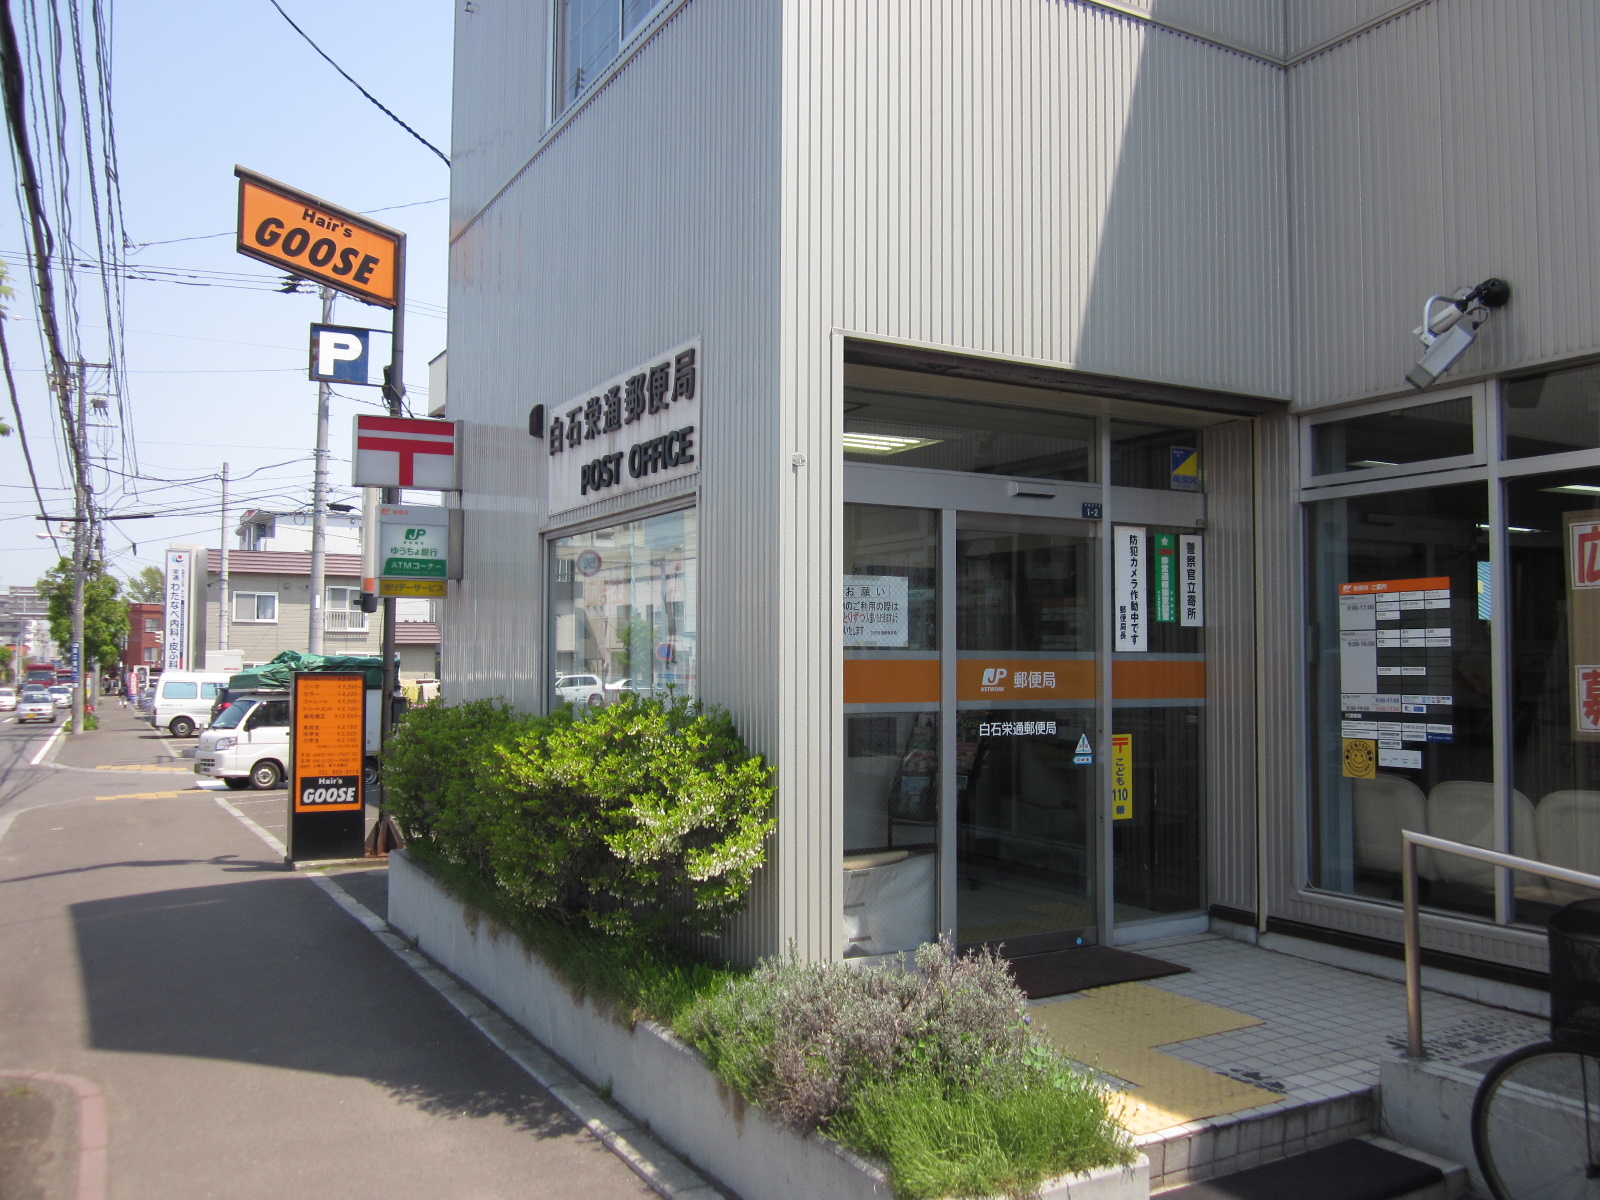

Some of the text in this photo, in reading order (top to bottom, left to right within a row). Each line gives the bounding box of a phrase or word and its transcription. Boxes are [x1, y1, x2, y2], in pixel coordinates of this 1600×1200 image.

[302, 208, 352, 238] Hair's
[255, 217, 380, 285] GOOSE
[318, 330, 363, 376] P
[550, 348, 696, 456] 白石栄通郵便局
[580, 426, 694, 495] POST OFFICE
[1086, 508, 1099, 517] 1-2
[404, 528, 426, 540] JP
[390, 547, 438, 557] ゆうちょ銀行
[391, 561, 442, 570] ATMコーナー
[384, 583, 444, 592] ホリデーサービス
[1129, 534, 1140, 645] 防犯カメラ作動中です
[1186, 542, 1196, 620] 警察官立寄所
[846, 586, 885, 596] お願い
[843, 602, 899, 612] のご利用の際は
[1119, 605, 1127, 640] 郵便局長
[982, 668, 1056, 689] JP 郵便局
[979, 721, 1057, 737] 白石栄通郵便局
[303, 787, 356, 803] GOOSE
